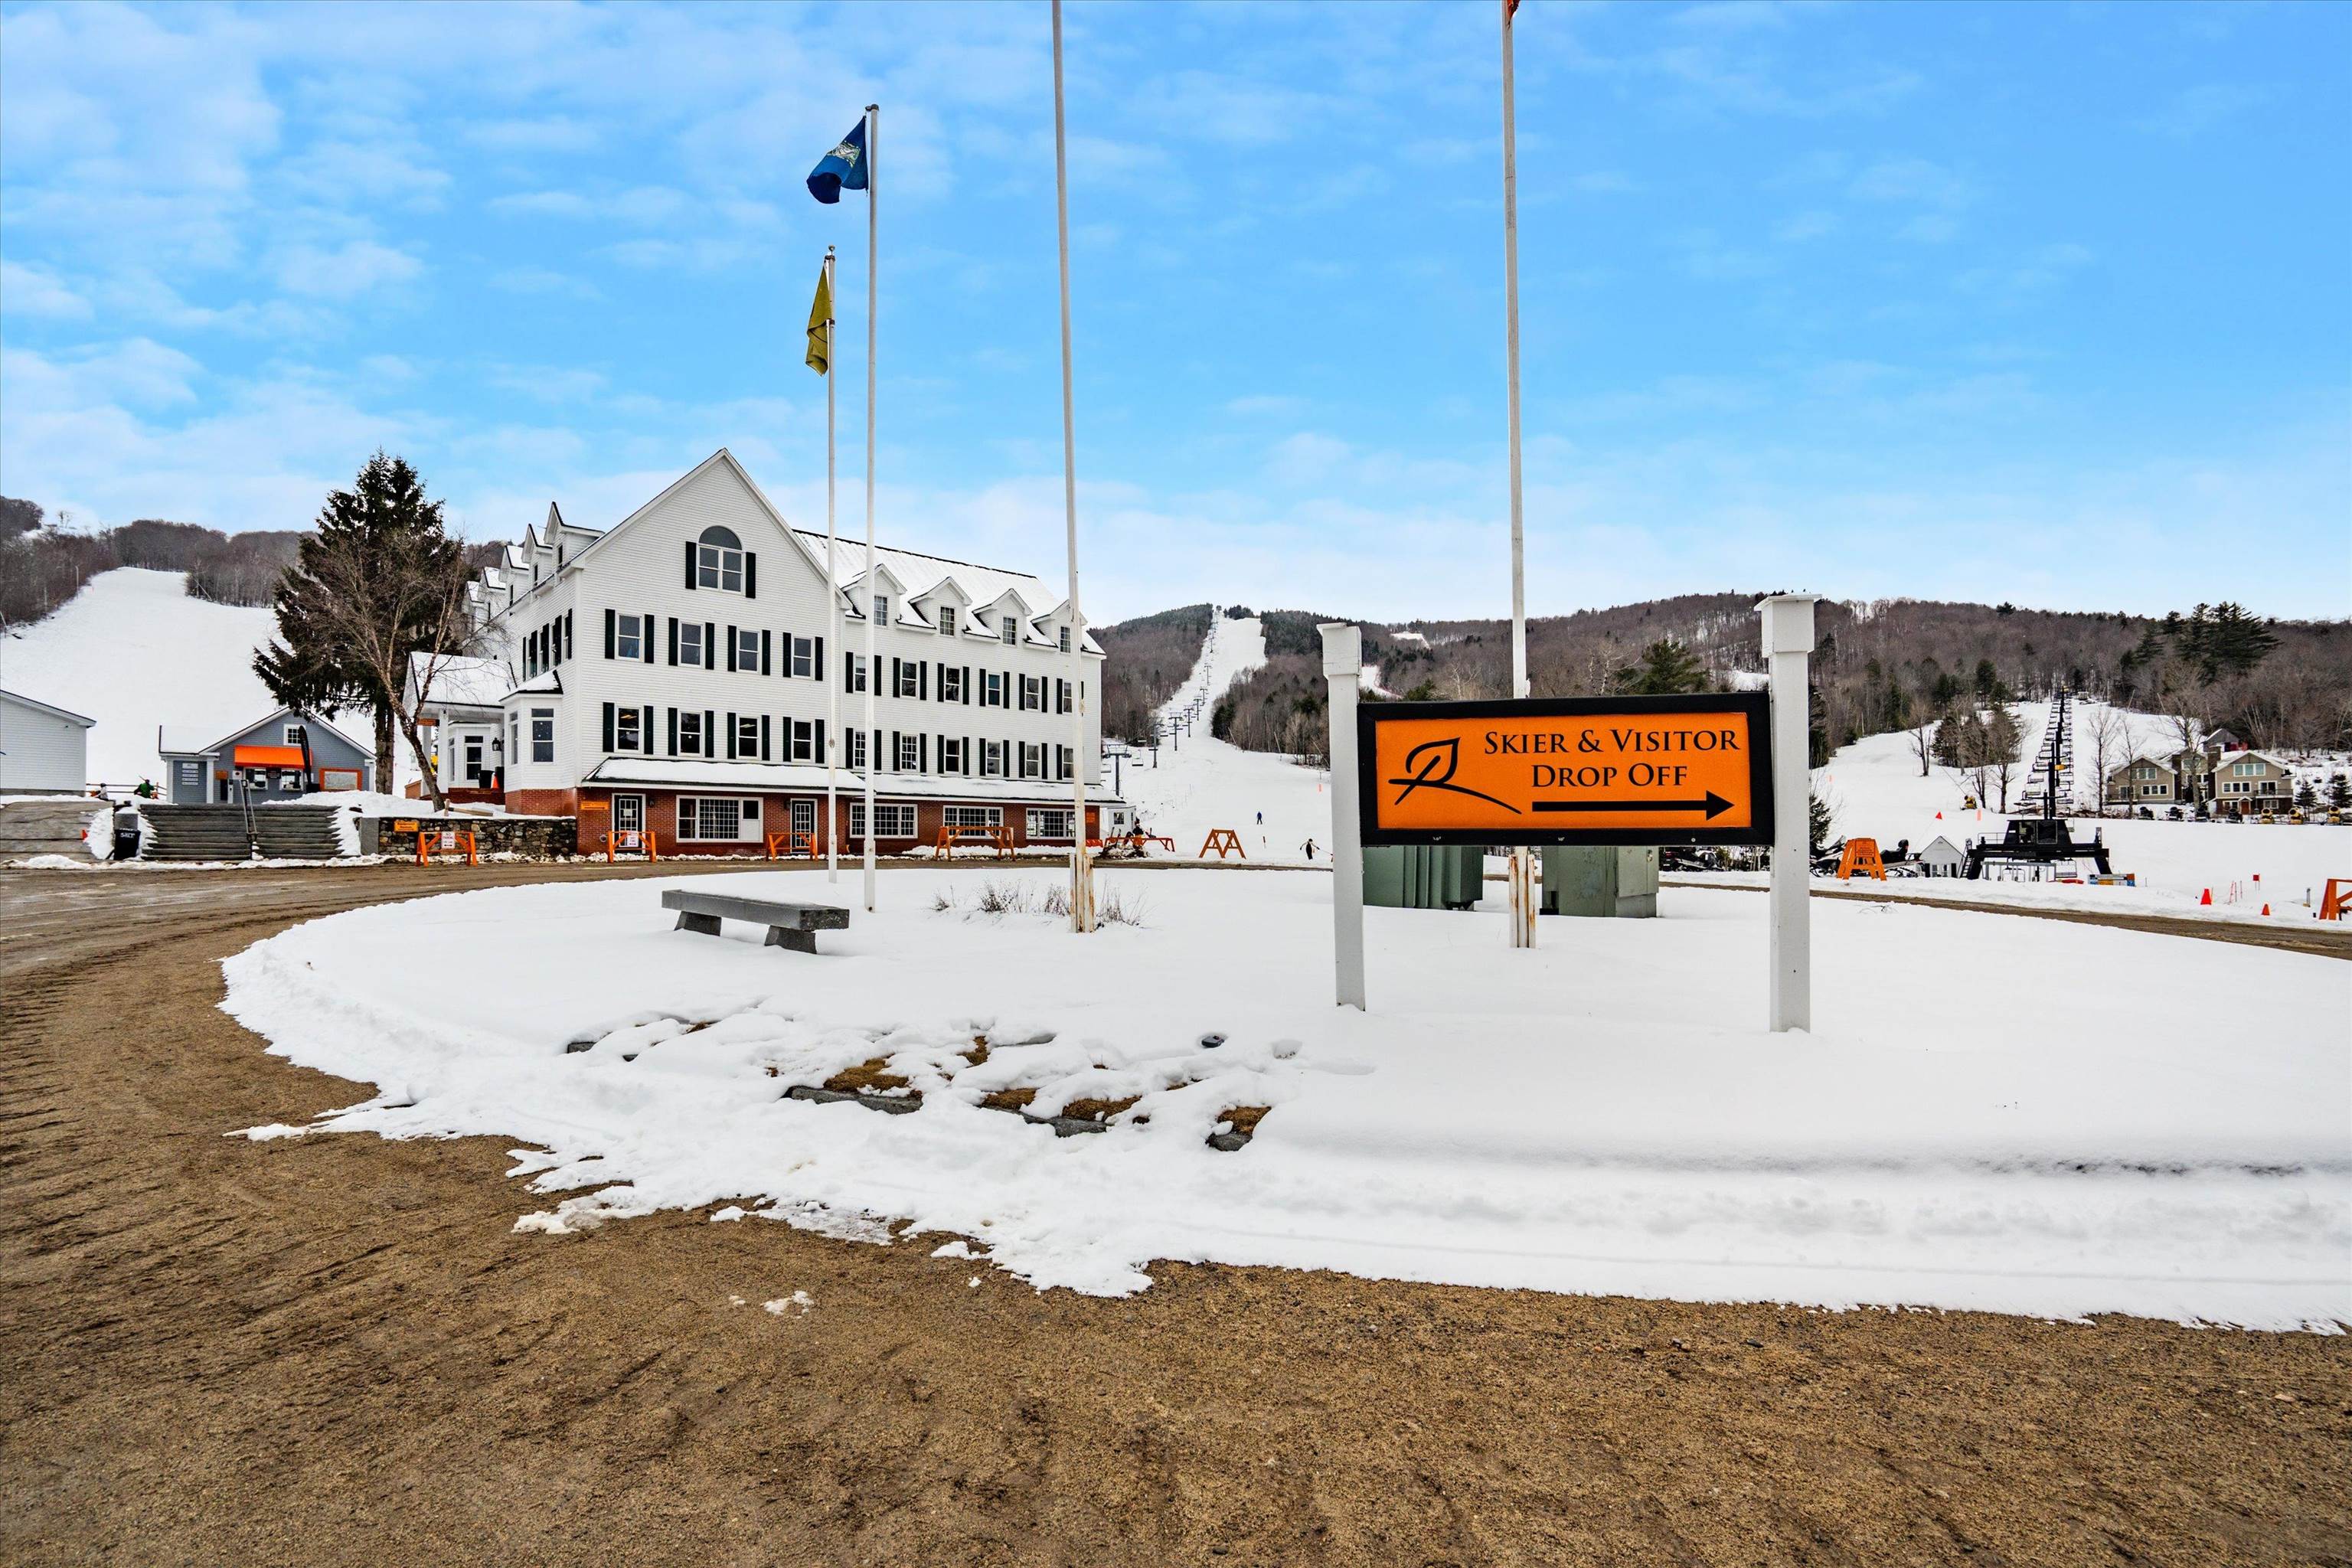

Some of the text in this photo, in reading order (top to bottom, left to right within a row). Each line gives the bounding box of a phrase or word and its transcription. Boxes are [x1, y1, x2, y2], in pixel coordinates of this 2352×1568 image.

[1484, 728, 1740, 755] SKIER & VISITOR
[1532, 763, 1687, 788] DROP OFF
